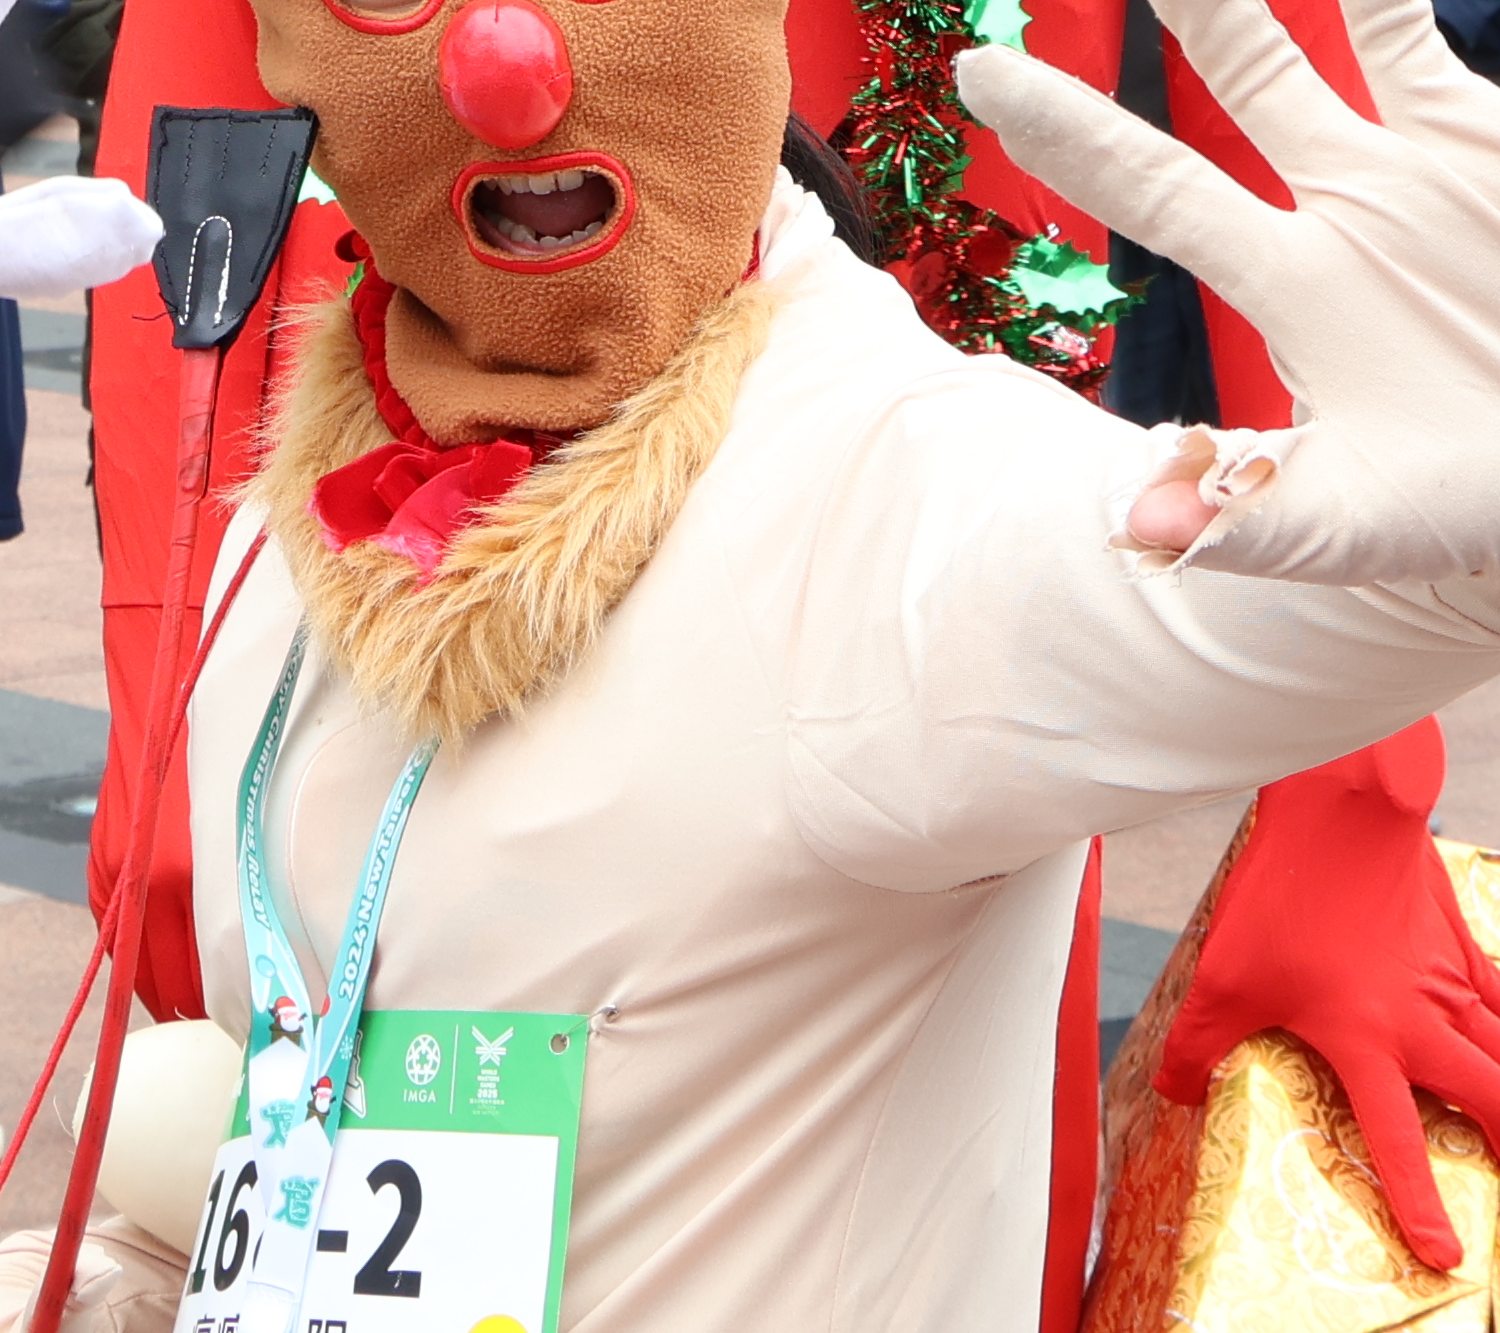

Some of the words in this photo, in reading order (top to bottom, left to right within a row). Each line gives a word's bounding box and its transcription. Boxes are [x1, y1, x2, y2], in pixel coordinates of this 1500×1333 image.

[339, 923, 368, 1001] 2024
[403, 1089, 437, 1103] IMGA
[186, 1159, 421, 1298] 16-2
